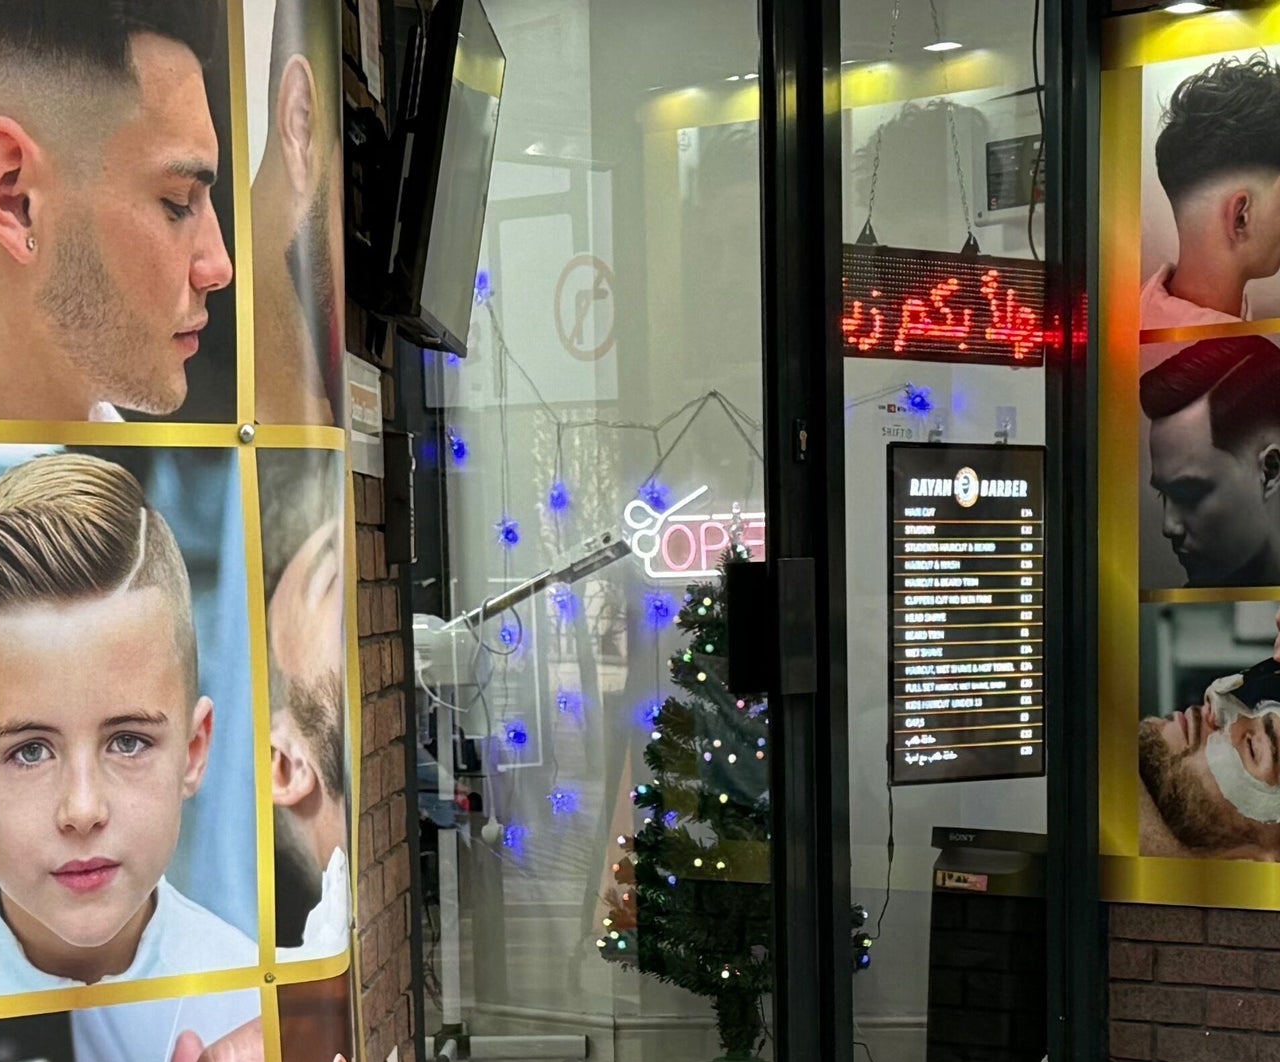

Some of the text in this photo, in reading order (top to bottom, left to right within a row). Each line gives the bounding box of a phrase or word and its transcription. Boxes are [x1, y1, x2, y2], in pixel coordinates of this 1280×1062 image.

[910, 479, 1028, 497] RAYAN BARBER
[948, 832, 976, 842] SONY
